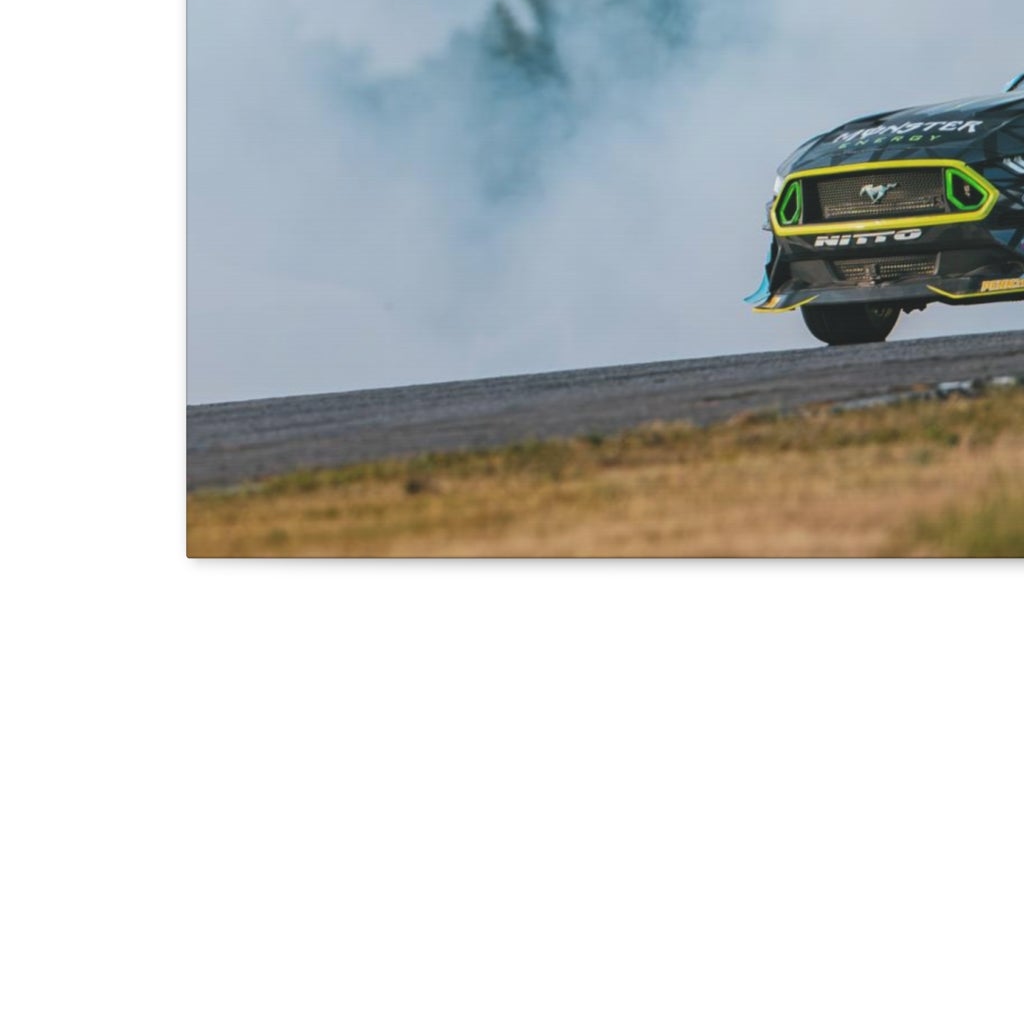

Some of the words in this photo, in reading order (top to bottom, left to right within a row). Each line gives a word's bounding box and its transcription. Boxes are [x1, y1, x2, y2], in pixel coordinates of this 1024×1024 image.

[832, 120, 983, 144] MONSTER
[838, 134, 942, 150] ENERGY
[814, 228, 922, 247] NITTO
